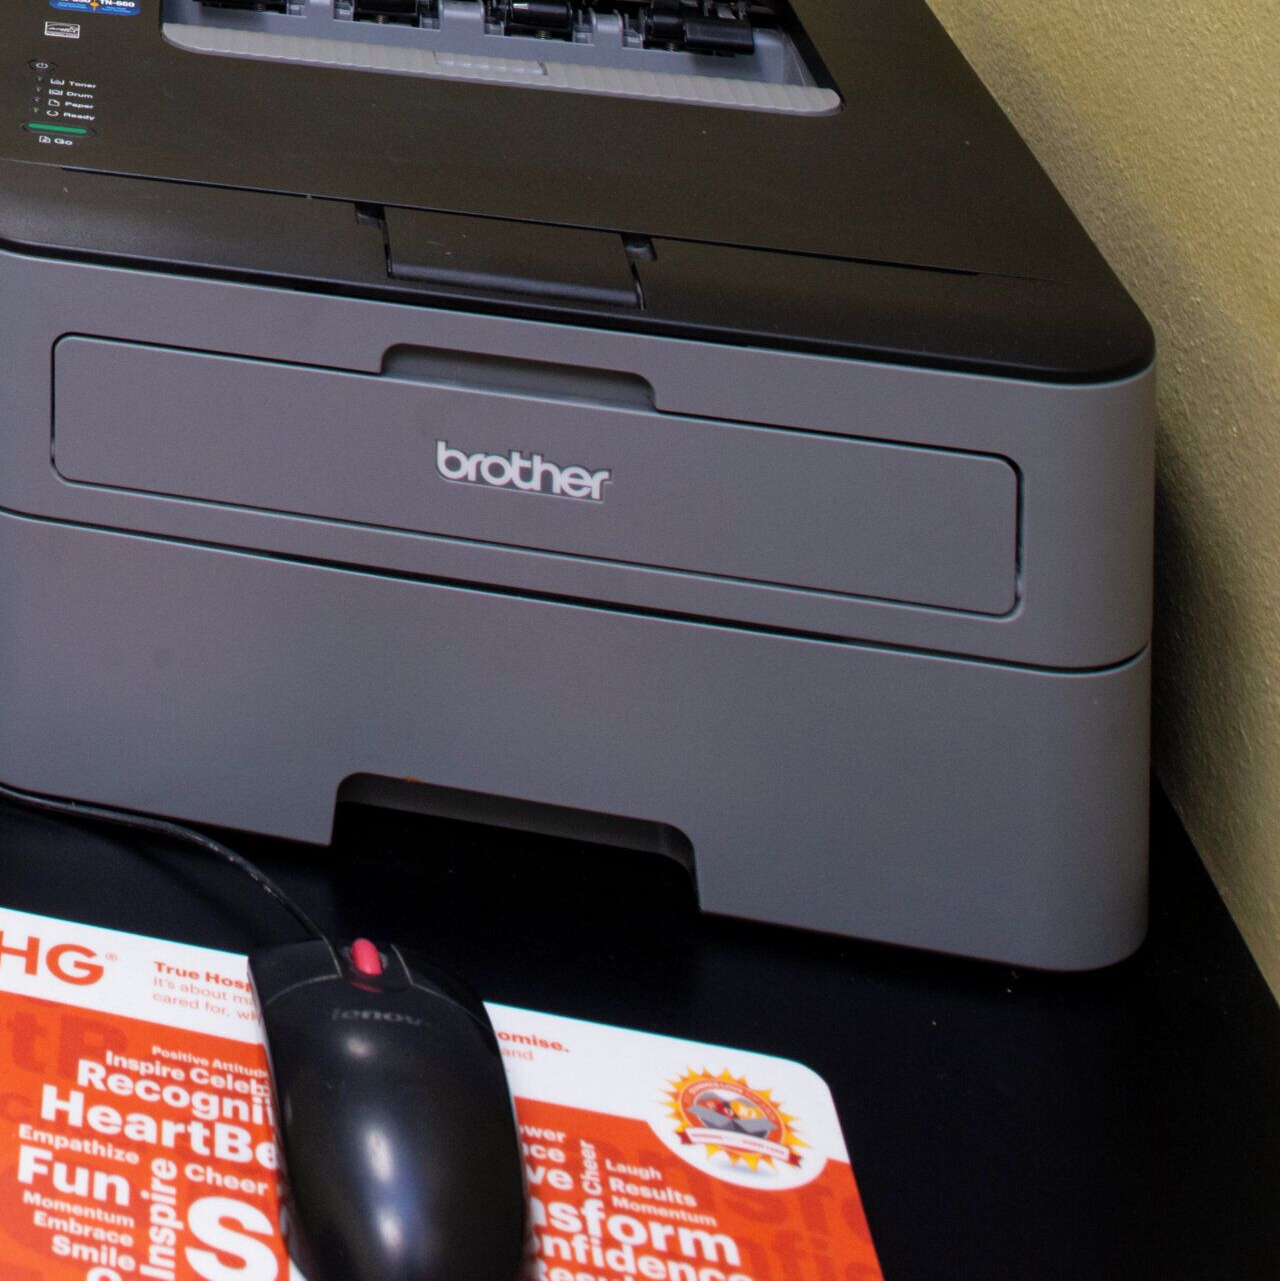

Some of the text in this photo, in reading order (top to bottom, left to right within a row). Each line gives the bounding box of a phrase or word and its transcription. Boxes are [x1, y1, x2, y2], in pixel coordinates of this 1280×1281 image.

[67, 91, 93, 99] Drum
[69, 80, 97, 89] Toner
[437, 440, 610, 500] brother
[154, 961, 199, 980] True
[106, 1051, 185, 1081] Inspire
[77, 1059, 274, 1125] Recogni
[19, 1123, 140, 1164] Empathize
[41, 1085, 279, 1170] HeartBe
[16, 1146, 130, 1206] Fun
[184, 1162, 269, 1198] Cheer
[605, 1159, 662, 1181] Laugh
[23, 1190, 135, 1228] Momentum
[608, 1177, 697, 1207] Results
[34, 1211, 134, 1247] Embrace
[52, 1236, 137, 1271] Smile
